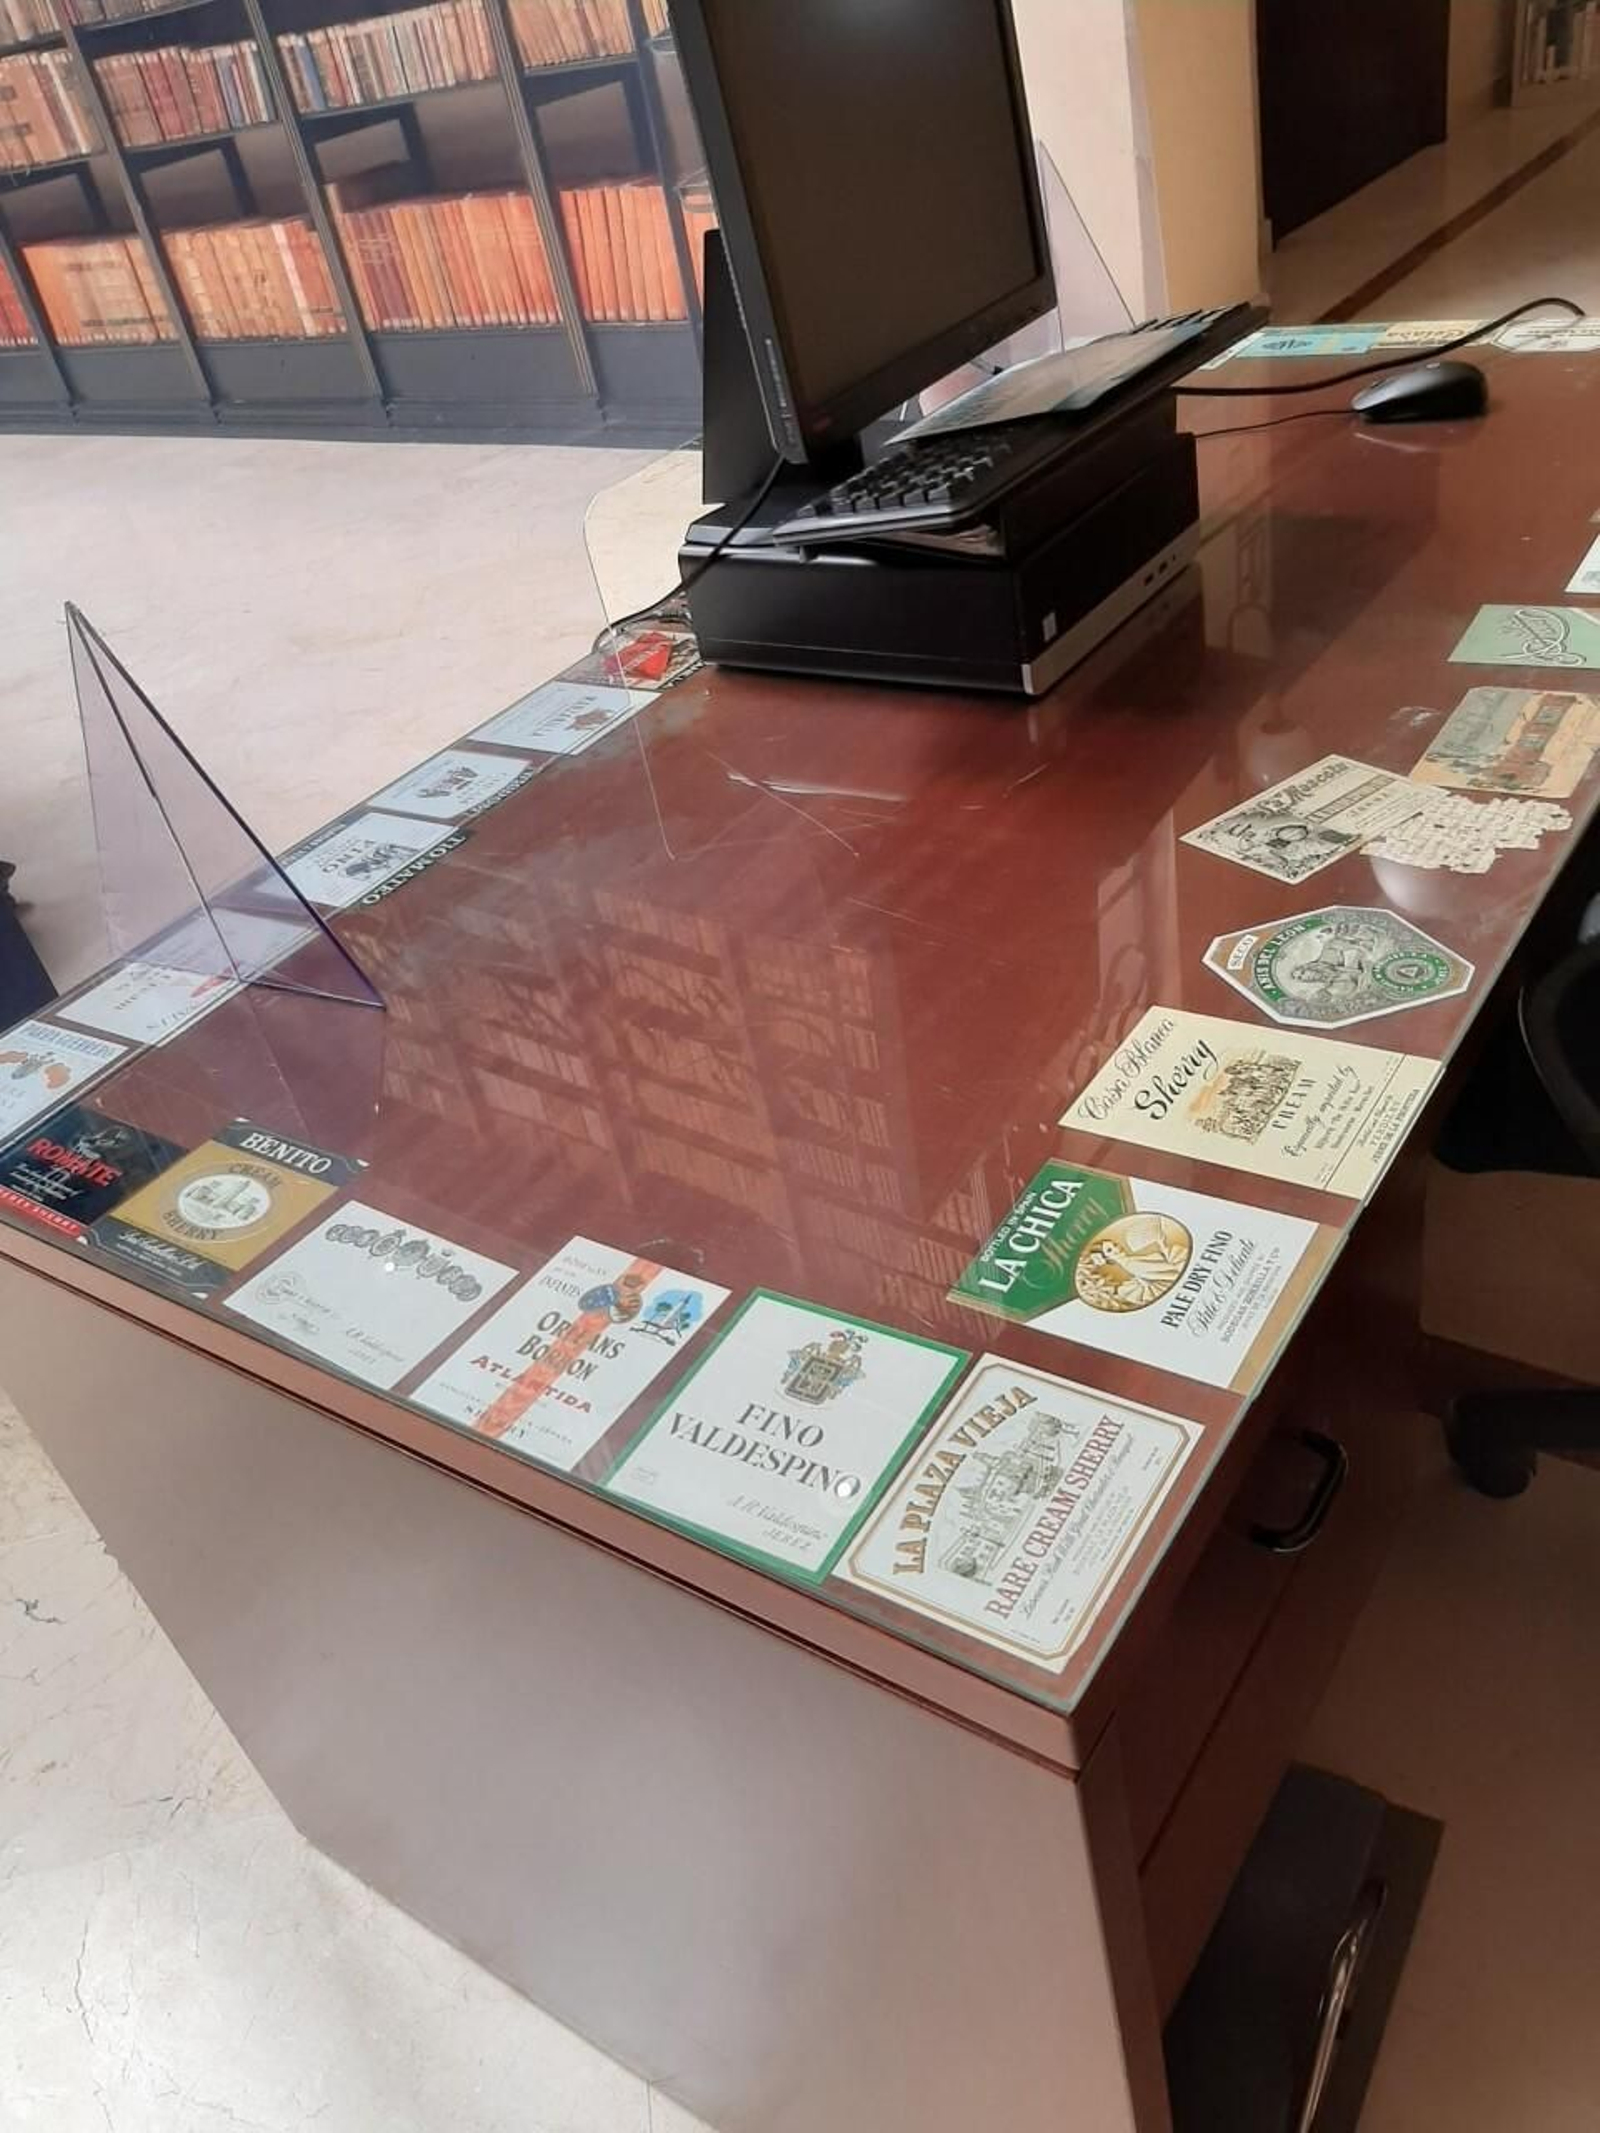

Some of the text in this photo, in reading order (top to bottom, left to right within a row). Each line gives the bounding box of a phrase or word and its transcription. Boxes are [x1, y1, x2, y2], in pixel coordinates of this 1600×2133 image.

[432, 834, 466, 857] TIO
[361, 852, 433, 904] MATEO
[1269, 924, 1305, 945] LEON
[1132, 1037, 1221, 1120] Sherry
[25, 1136, 123, 1187] ROMATE
[238, 1131, 335, 1175] BENITO
[978, 1177, 1085, 1294] LA CHICA
[1160, 1230, 1233, 1329] PALE DRY FINO
[533, 1309, 631, 1360] ORLEANS
[735, 1401, 829, 1451] FINO
[664, 1412, 866, 1502] VALDESPINO
[891, 1384, 1037, 1574] LA PLAZA VIEJA
[984, 1556, 1039, 1618] RARE
[1019, 1487, 1081, 1560] CREAM
[1061, 1413, 1127, 1491] SHERRY
